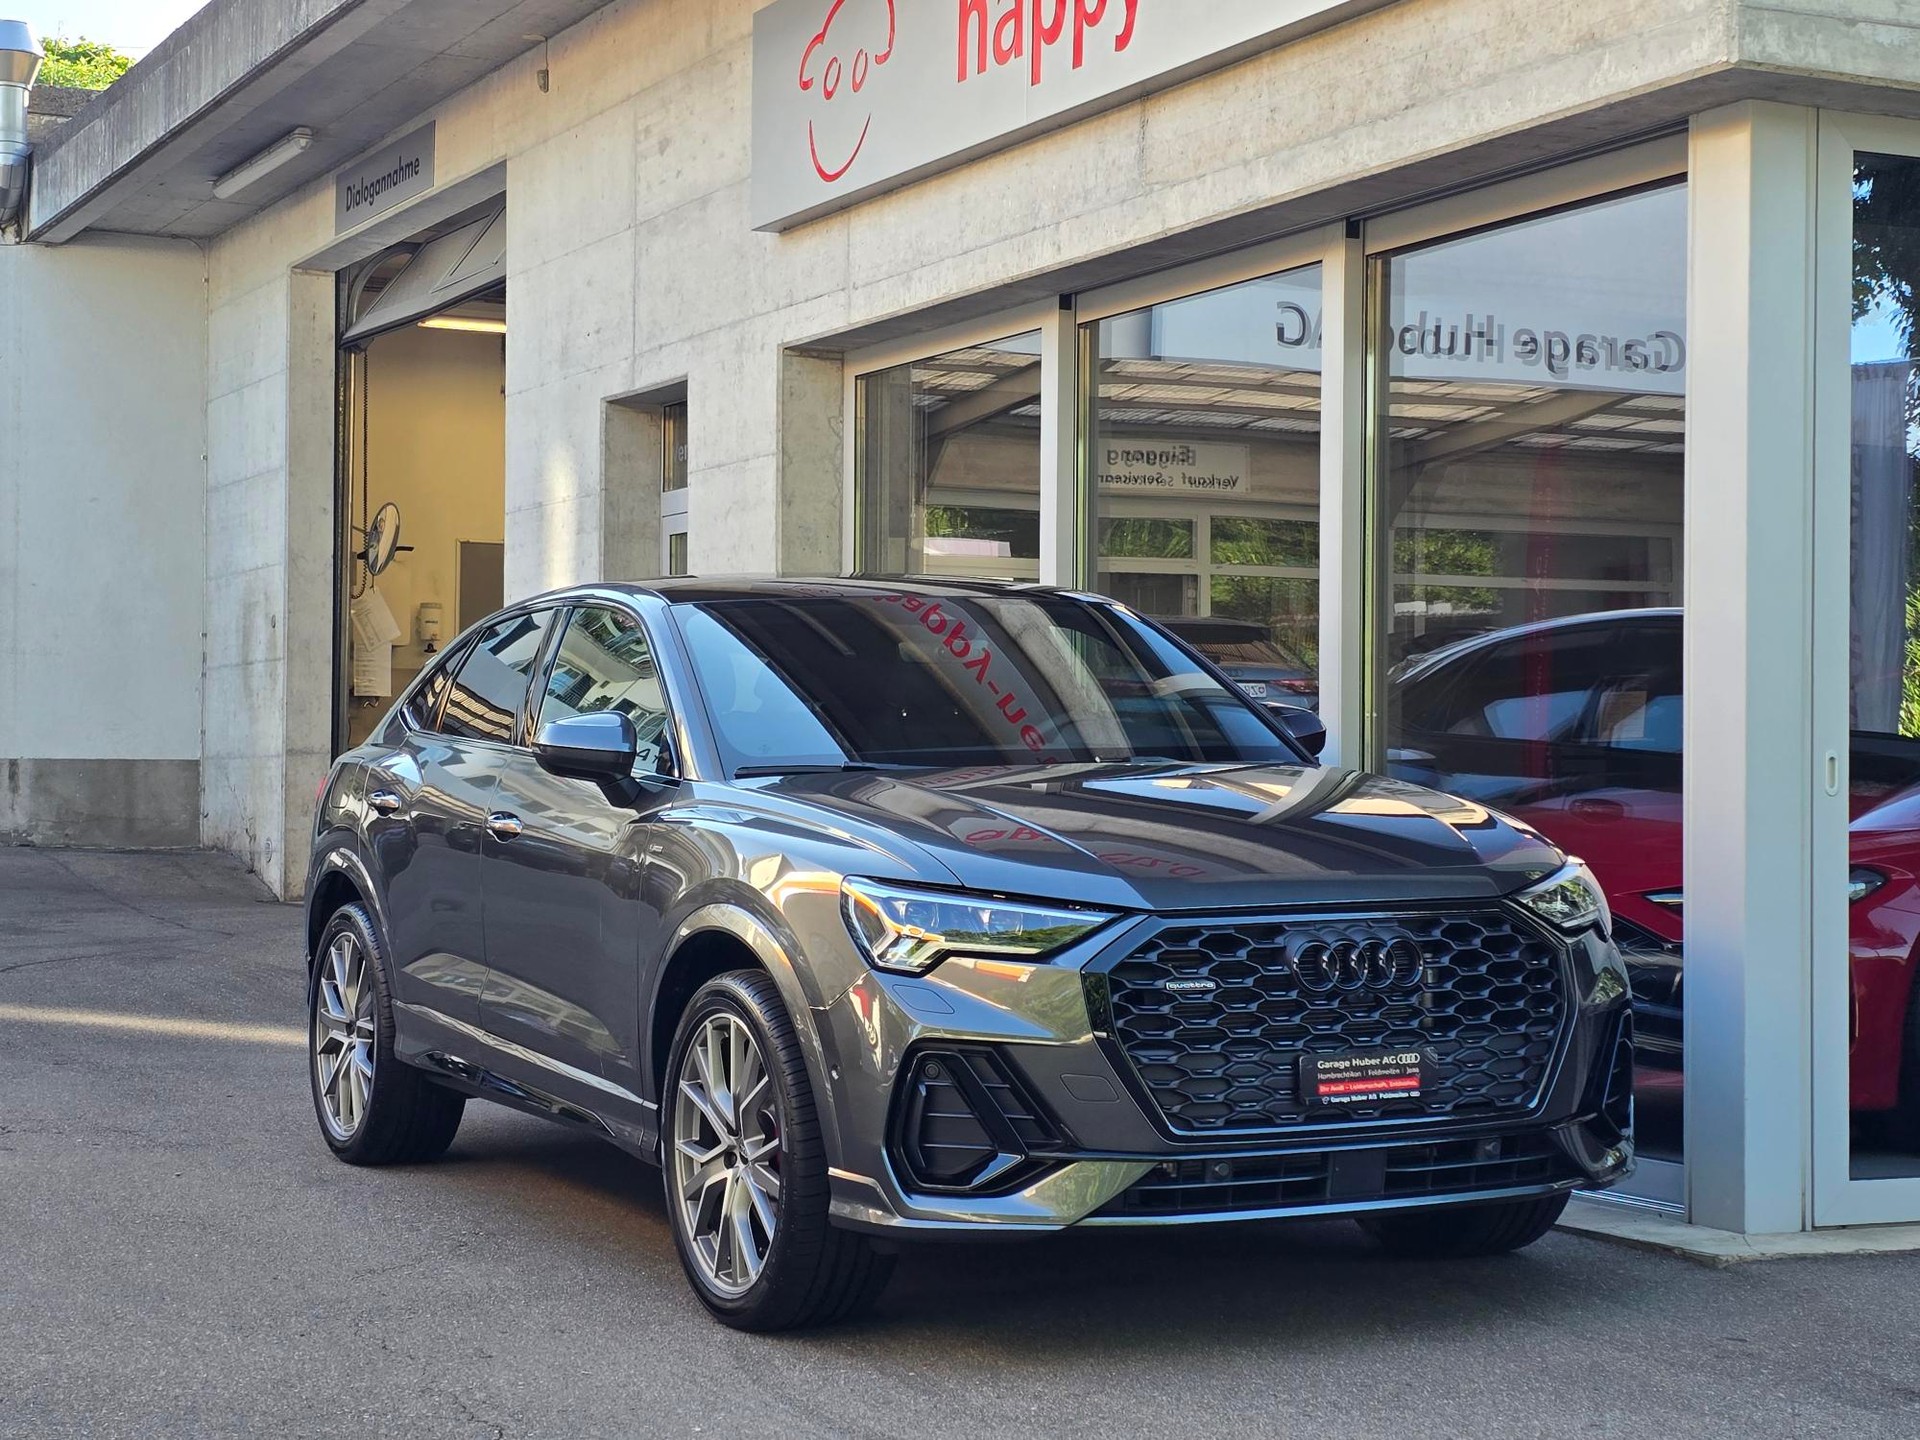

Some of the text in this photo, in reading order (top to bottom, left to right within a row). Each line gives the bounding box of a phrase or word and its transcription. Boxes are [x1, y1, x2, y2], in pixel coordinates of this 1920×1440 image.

[346, 155, 420, 212] Dialogannahme
[1168, 981, 1215, 991] quattro
[1317, 1056, 1396, 1069] Garage Huber AG
